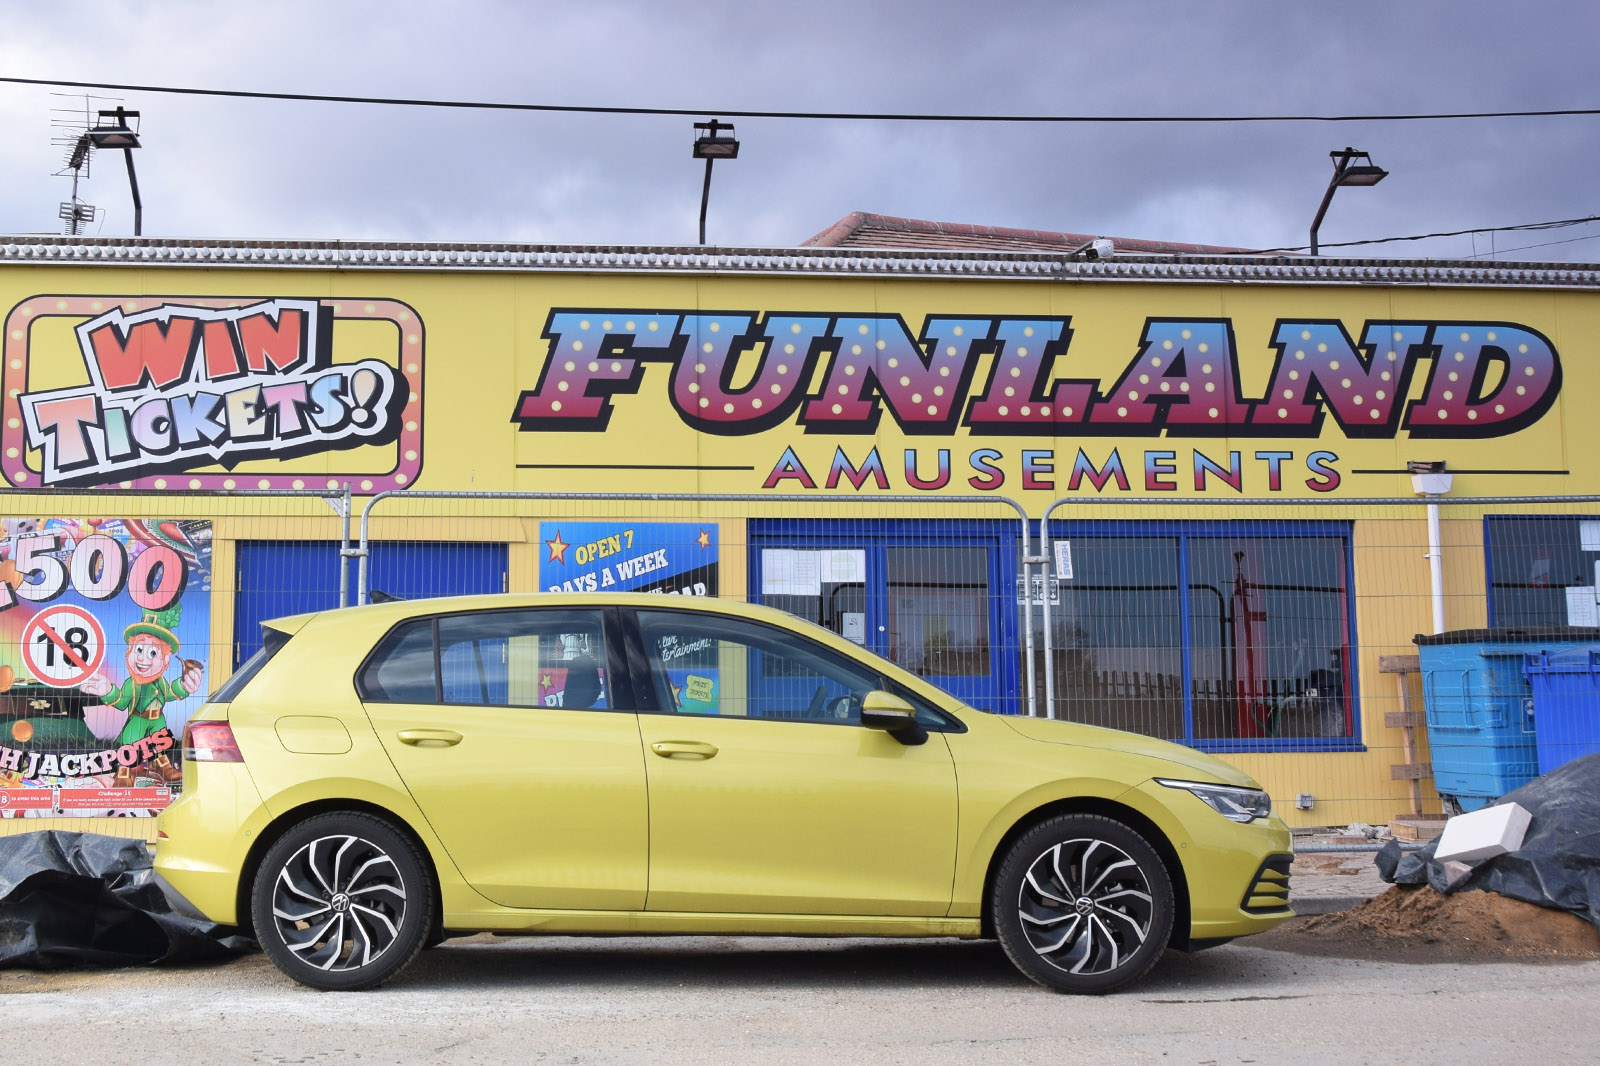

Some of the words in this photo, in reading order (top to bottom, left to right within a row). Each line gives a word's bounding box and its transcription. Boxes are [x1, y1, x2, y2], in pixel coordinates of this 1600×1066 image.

[88, 307, 303, 391] WIN
[513, 309, 1560, 433] FUNLAND
[34, 368, 379, 467] TICKETS!
[761, 444, 1342, 493] AMUSEMENTS
[575, 533, 622, 566] OPEN
[623, 529, 634, 549] 7
[601, 567, 616, 588] A
[616, 548, 669, 582] WEEK
[1061, 543, 1071, 576] HERAS
[37, 626, 90, 669] 18
[24, 728, 173, 778] JACKPOTS
